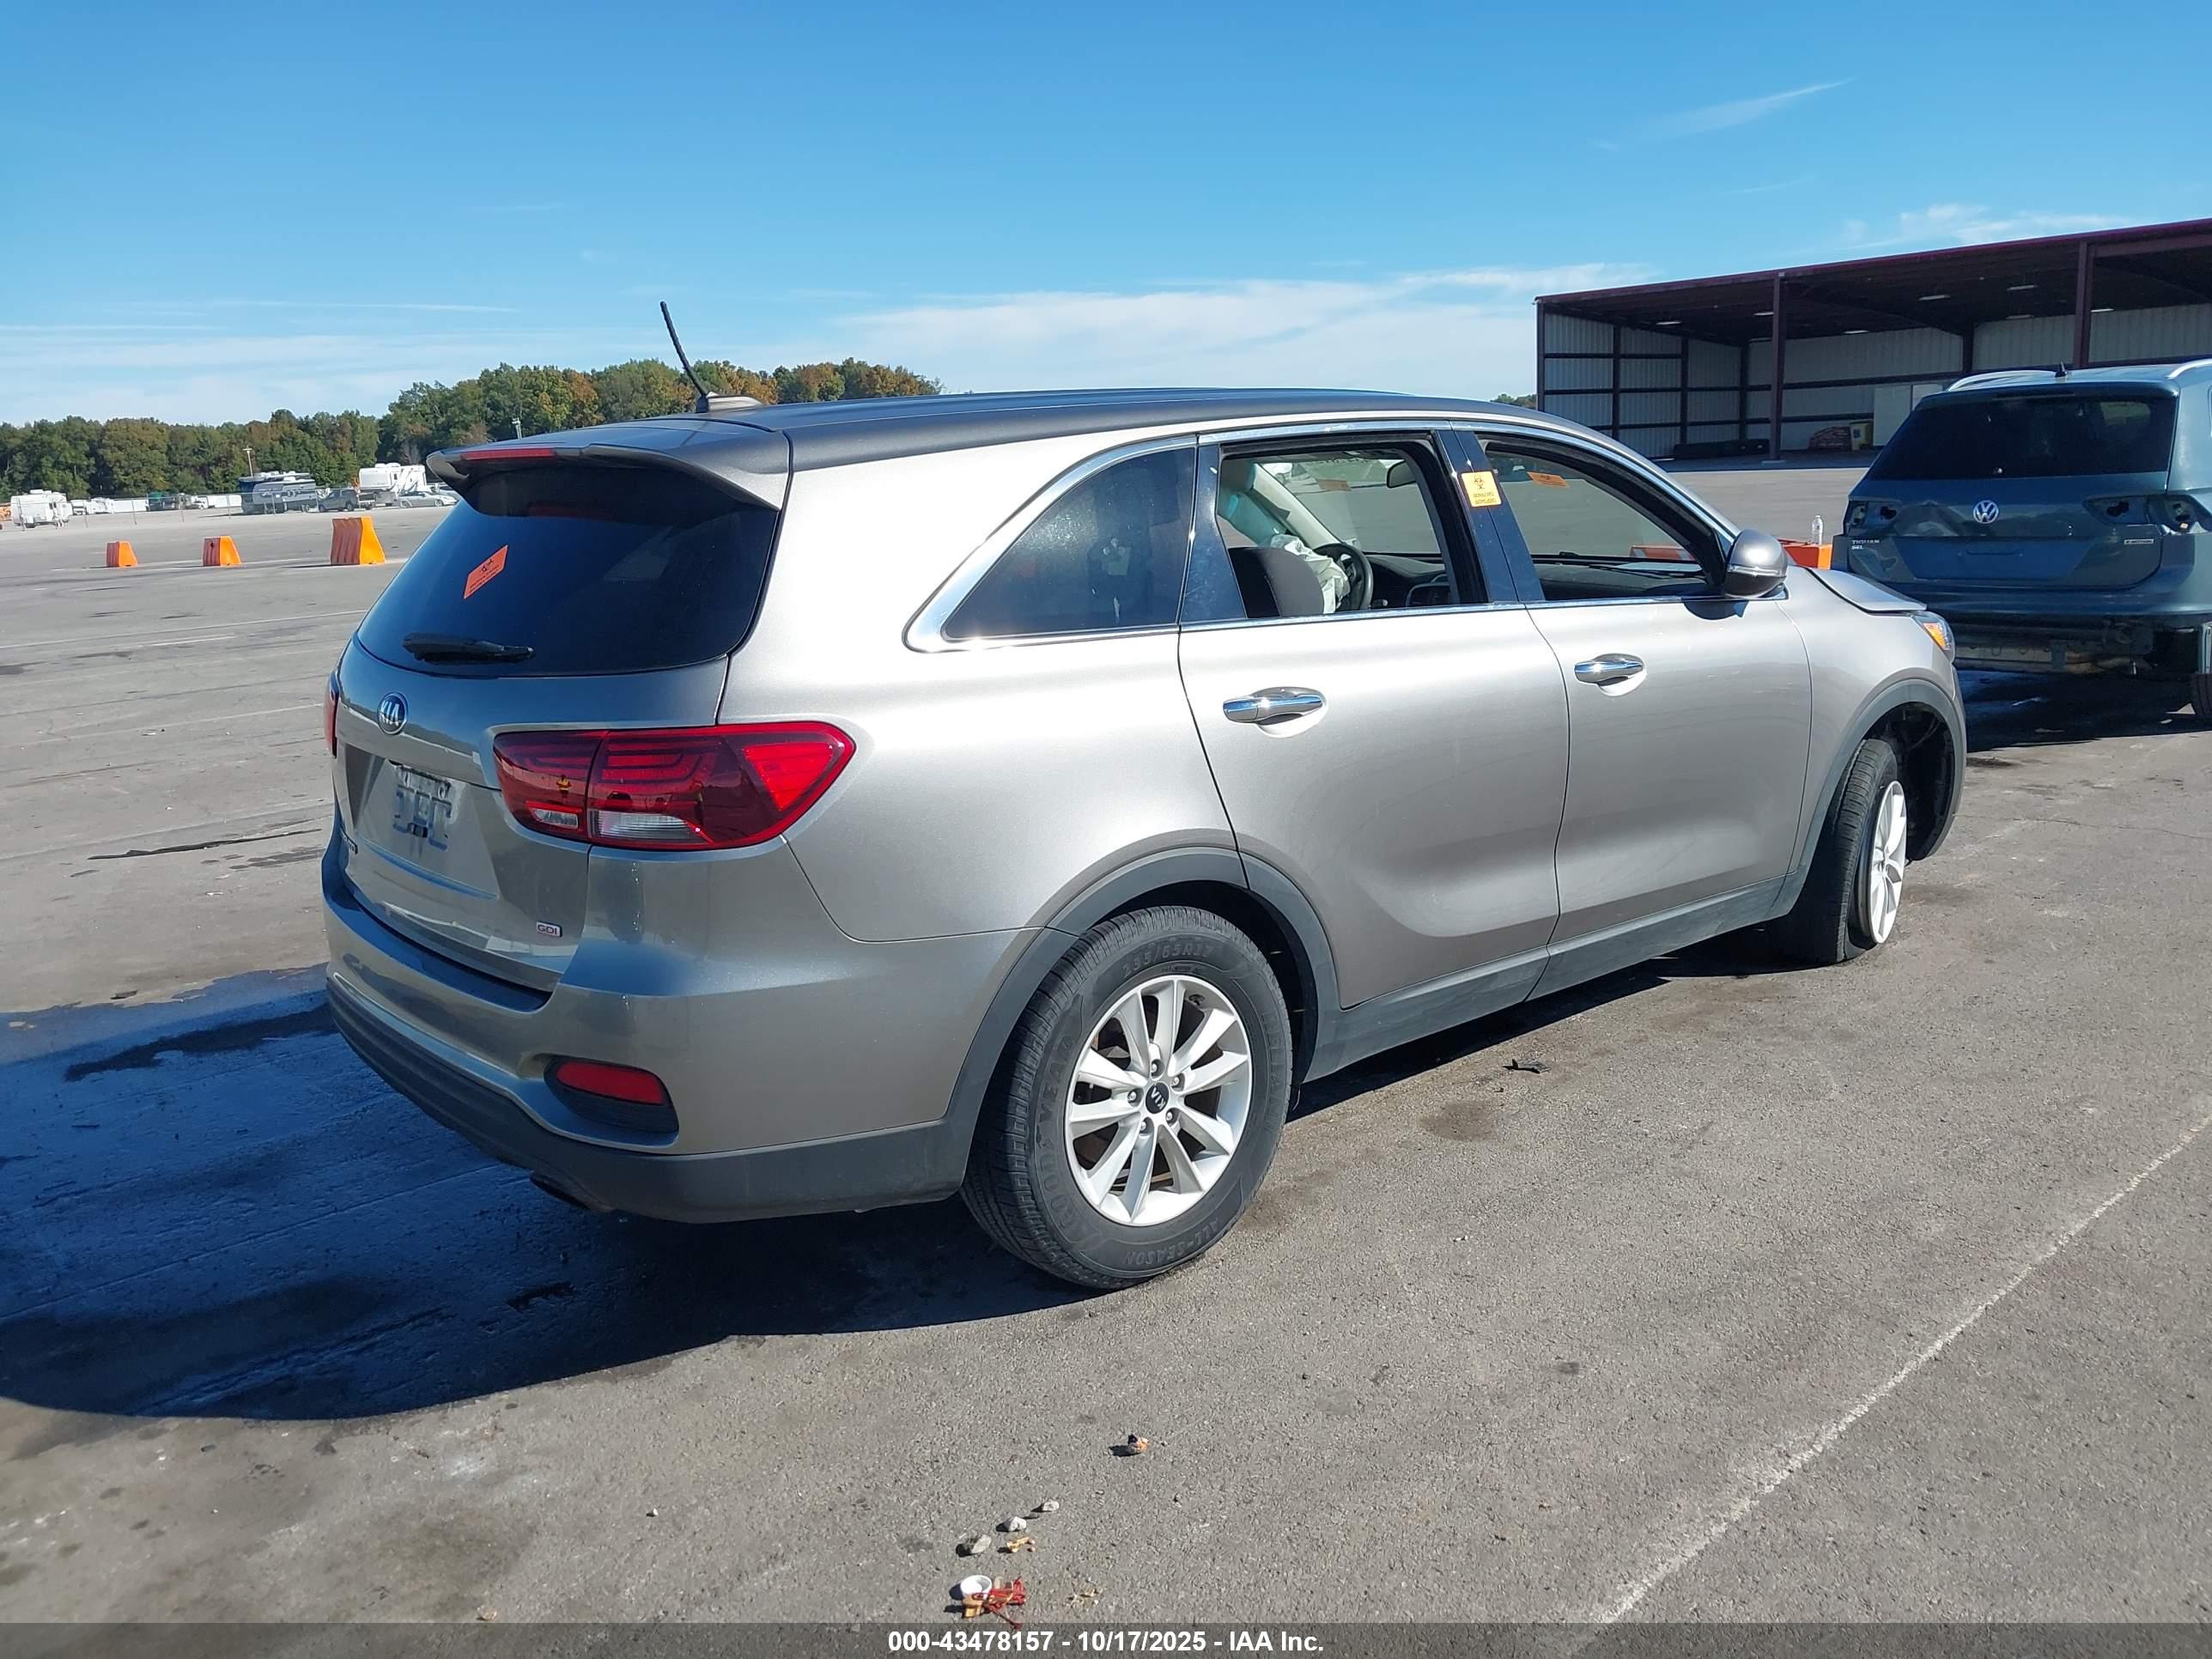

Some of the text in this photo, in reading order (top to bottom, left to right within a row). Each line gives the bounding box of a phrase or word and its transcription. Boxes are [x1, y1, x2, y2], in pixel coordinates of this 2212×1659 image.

[1973, 500, 1998, 523] VW
[538, 924, 557, 935] GDI
[1150, 1085, 1167, 1110] KIA
